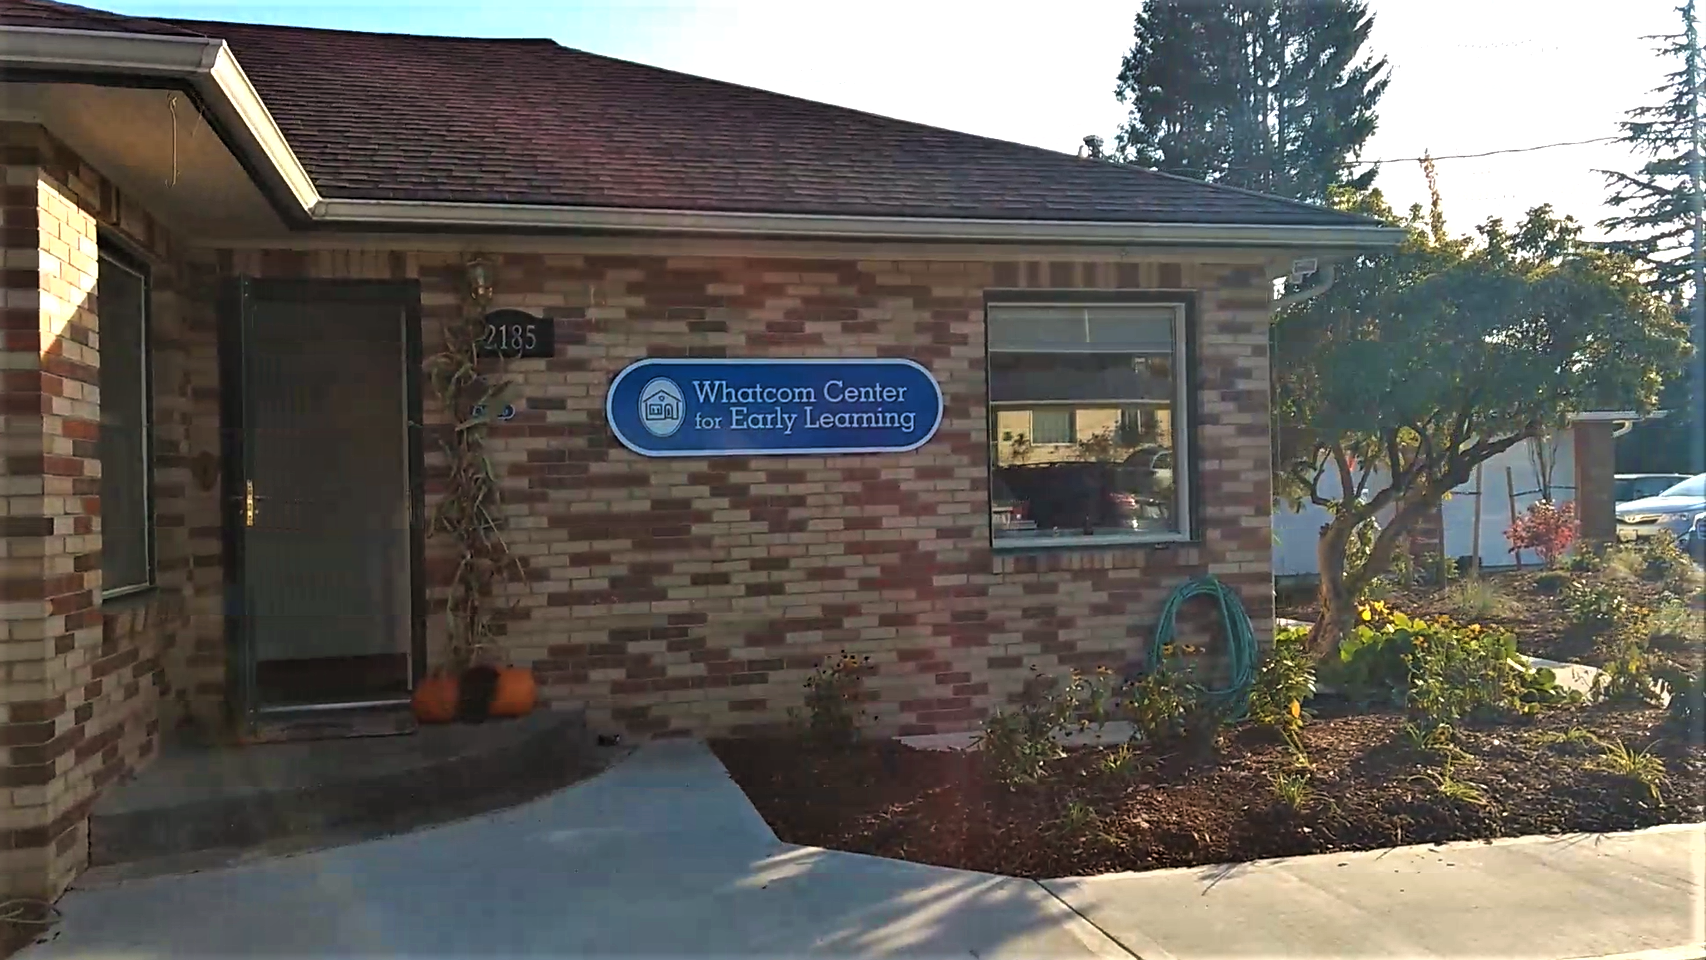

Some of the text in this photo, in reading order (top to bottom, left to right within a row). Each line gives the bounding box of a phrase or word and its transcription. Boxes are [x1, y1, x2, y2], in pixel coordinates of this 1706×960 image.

[483, 324, 537, 350] 2185
[692, 379, 907, 404] Whatcom Center
[694, 406, 916, 434] for Early Learning
